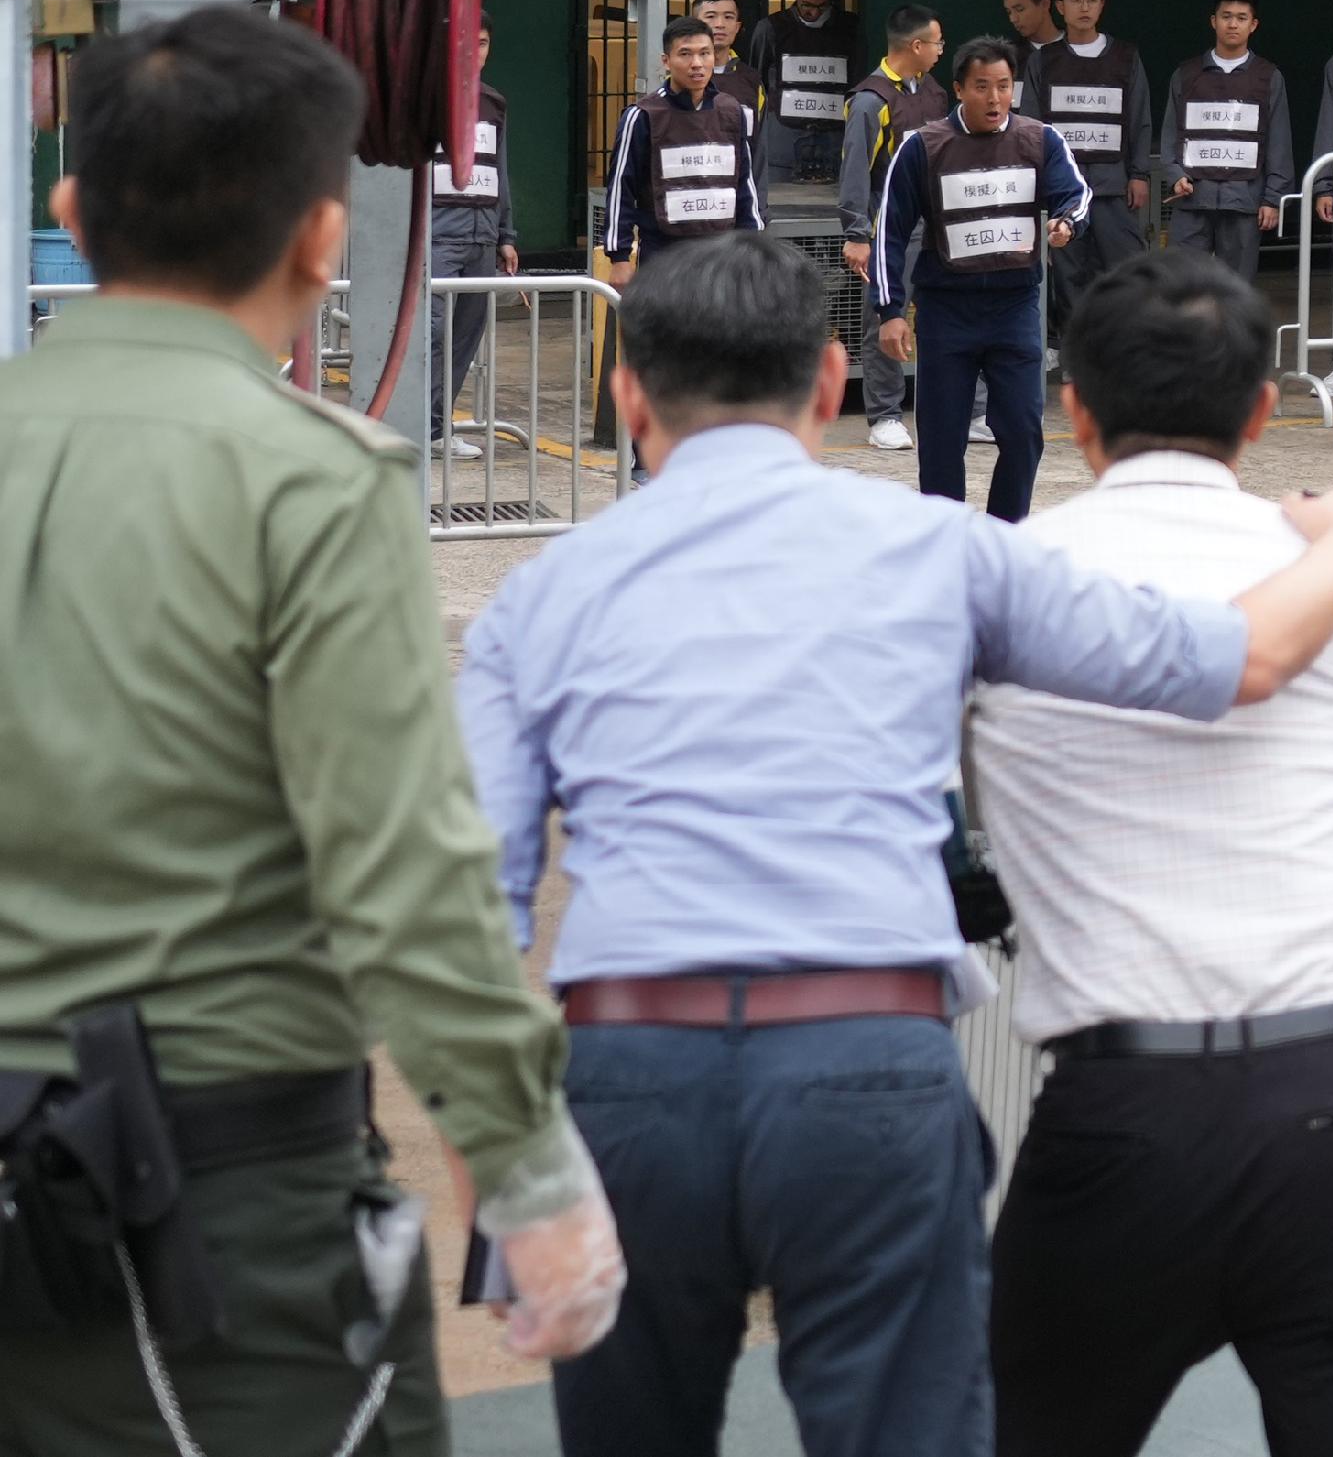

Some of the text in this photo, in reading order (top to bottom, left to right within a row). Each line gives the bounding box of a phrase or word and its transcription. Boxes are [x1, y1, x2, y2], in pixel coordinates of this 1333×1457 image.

[795, 99, 838, 112] 在囚人士
[1065, 130, 1109, 143] 在囚人士
[1200, 148, 1245, 161] 在囚人士
[965, 182, 1017, 197] 模擬人員
[682, 199, 727, 212] 在囚人士
[965, 229, 1022, 247] 在囚人士
